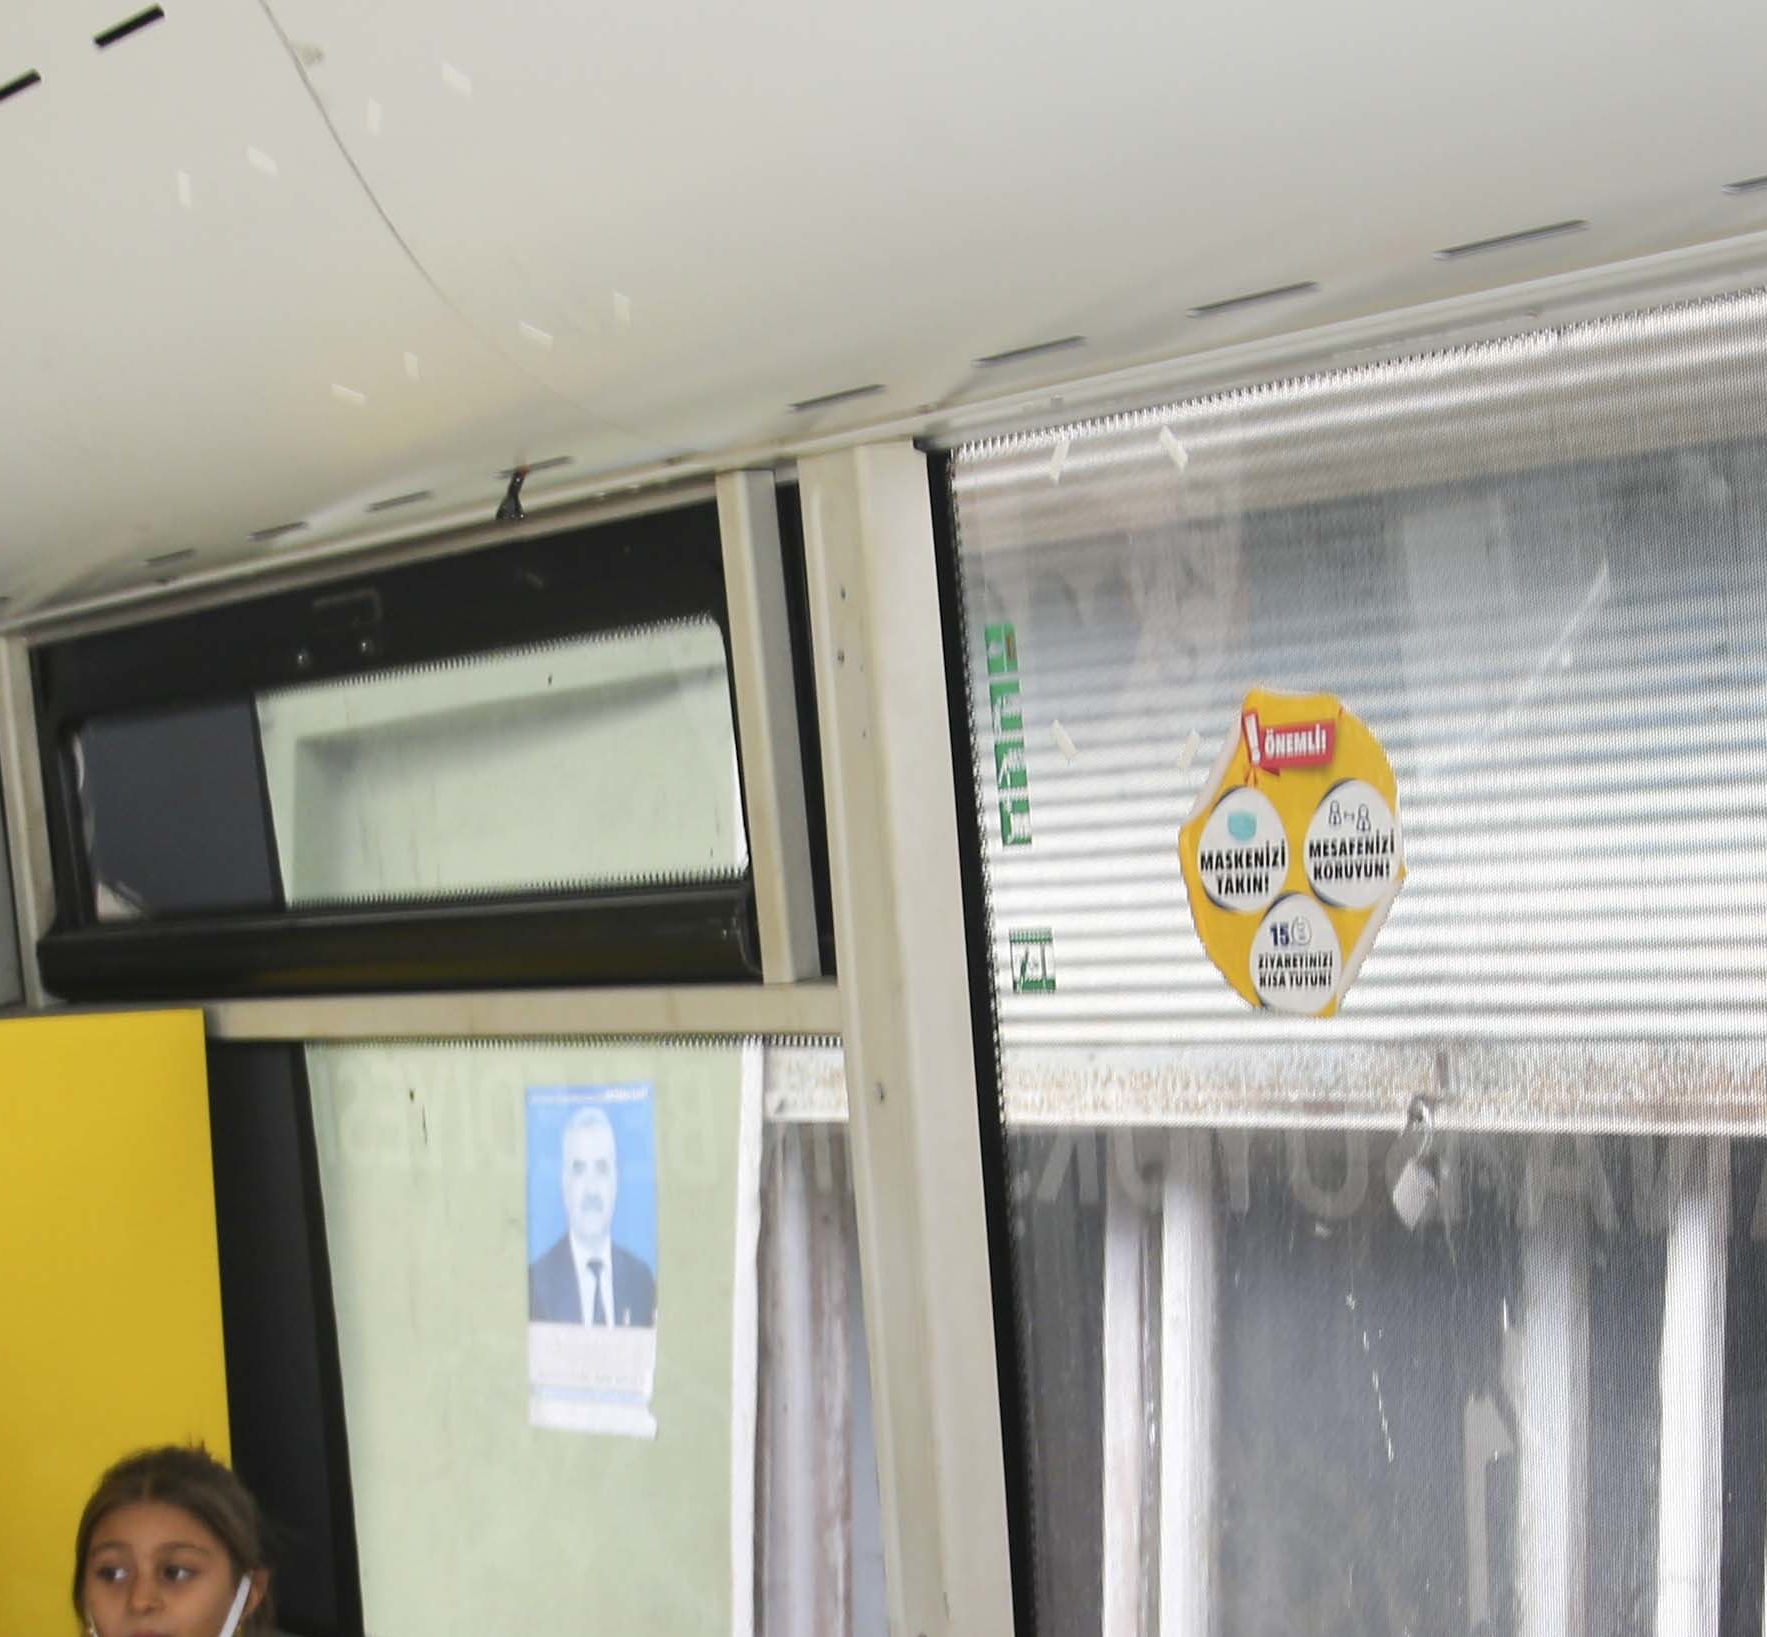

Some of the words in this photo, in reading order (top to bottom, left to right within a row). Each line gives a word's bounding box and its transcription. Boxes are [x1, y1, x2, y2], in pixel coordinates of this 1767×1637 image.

[1265, 723, 1327, 758] ÖNEMLİ!
[1200, 840, 1286, 871] MASKENİZİ
[1308, 828, 1395, 859] MESAFENİZİ
[1313, 858, 1390, 881] KORUYUN!
[1217, 873, 1269, 896] TAKIN!
[1270, 922, 1289, 947] 15
